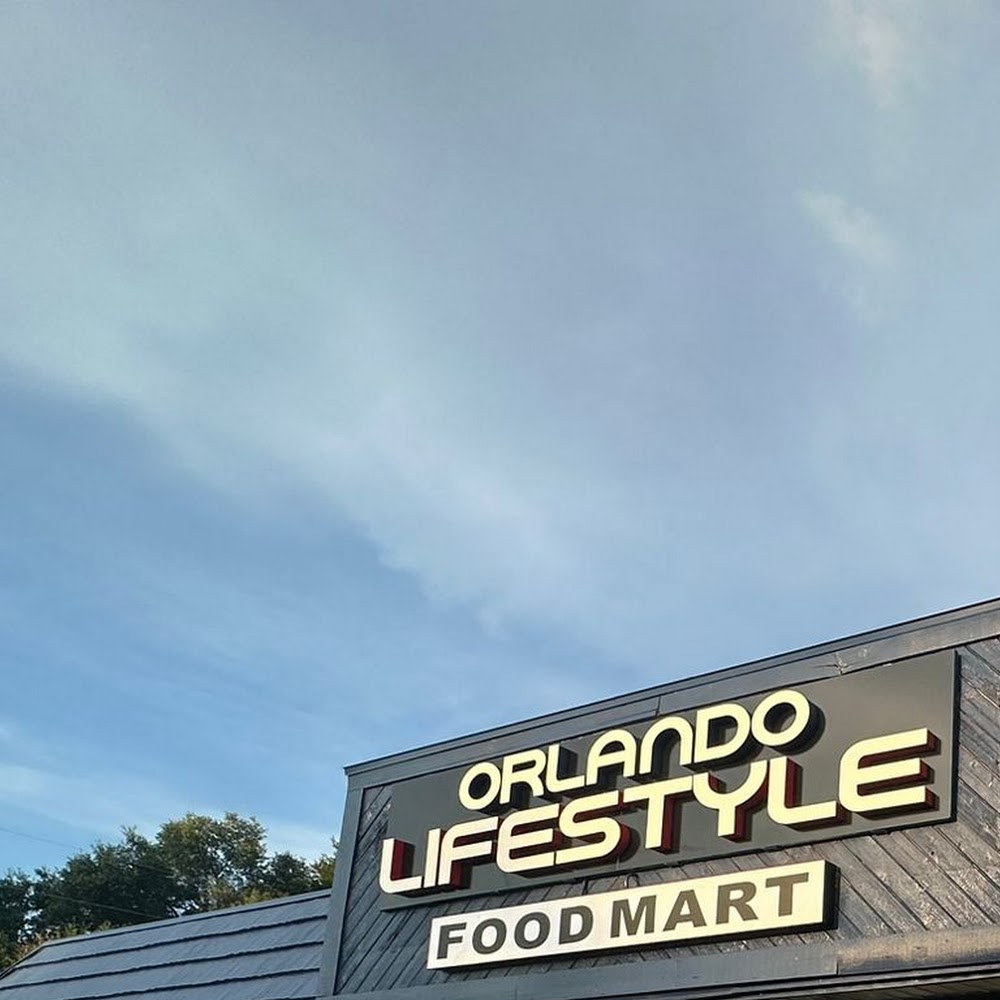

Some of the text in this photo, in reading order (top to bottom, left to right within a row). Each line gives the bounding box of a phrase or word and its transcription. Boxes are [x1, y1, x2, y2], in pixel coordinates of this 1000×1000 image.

[379, 727, 931, 894] LIFESTYLE
[459, 690, 811, 811] ORLANDO
[436, 872, 810, 960] FOOD MART
